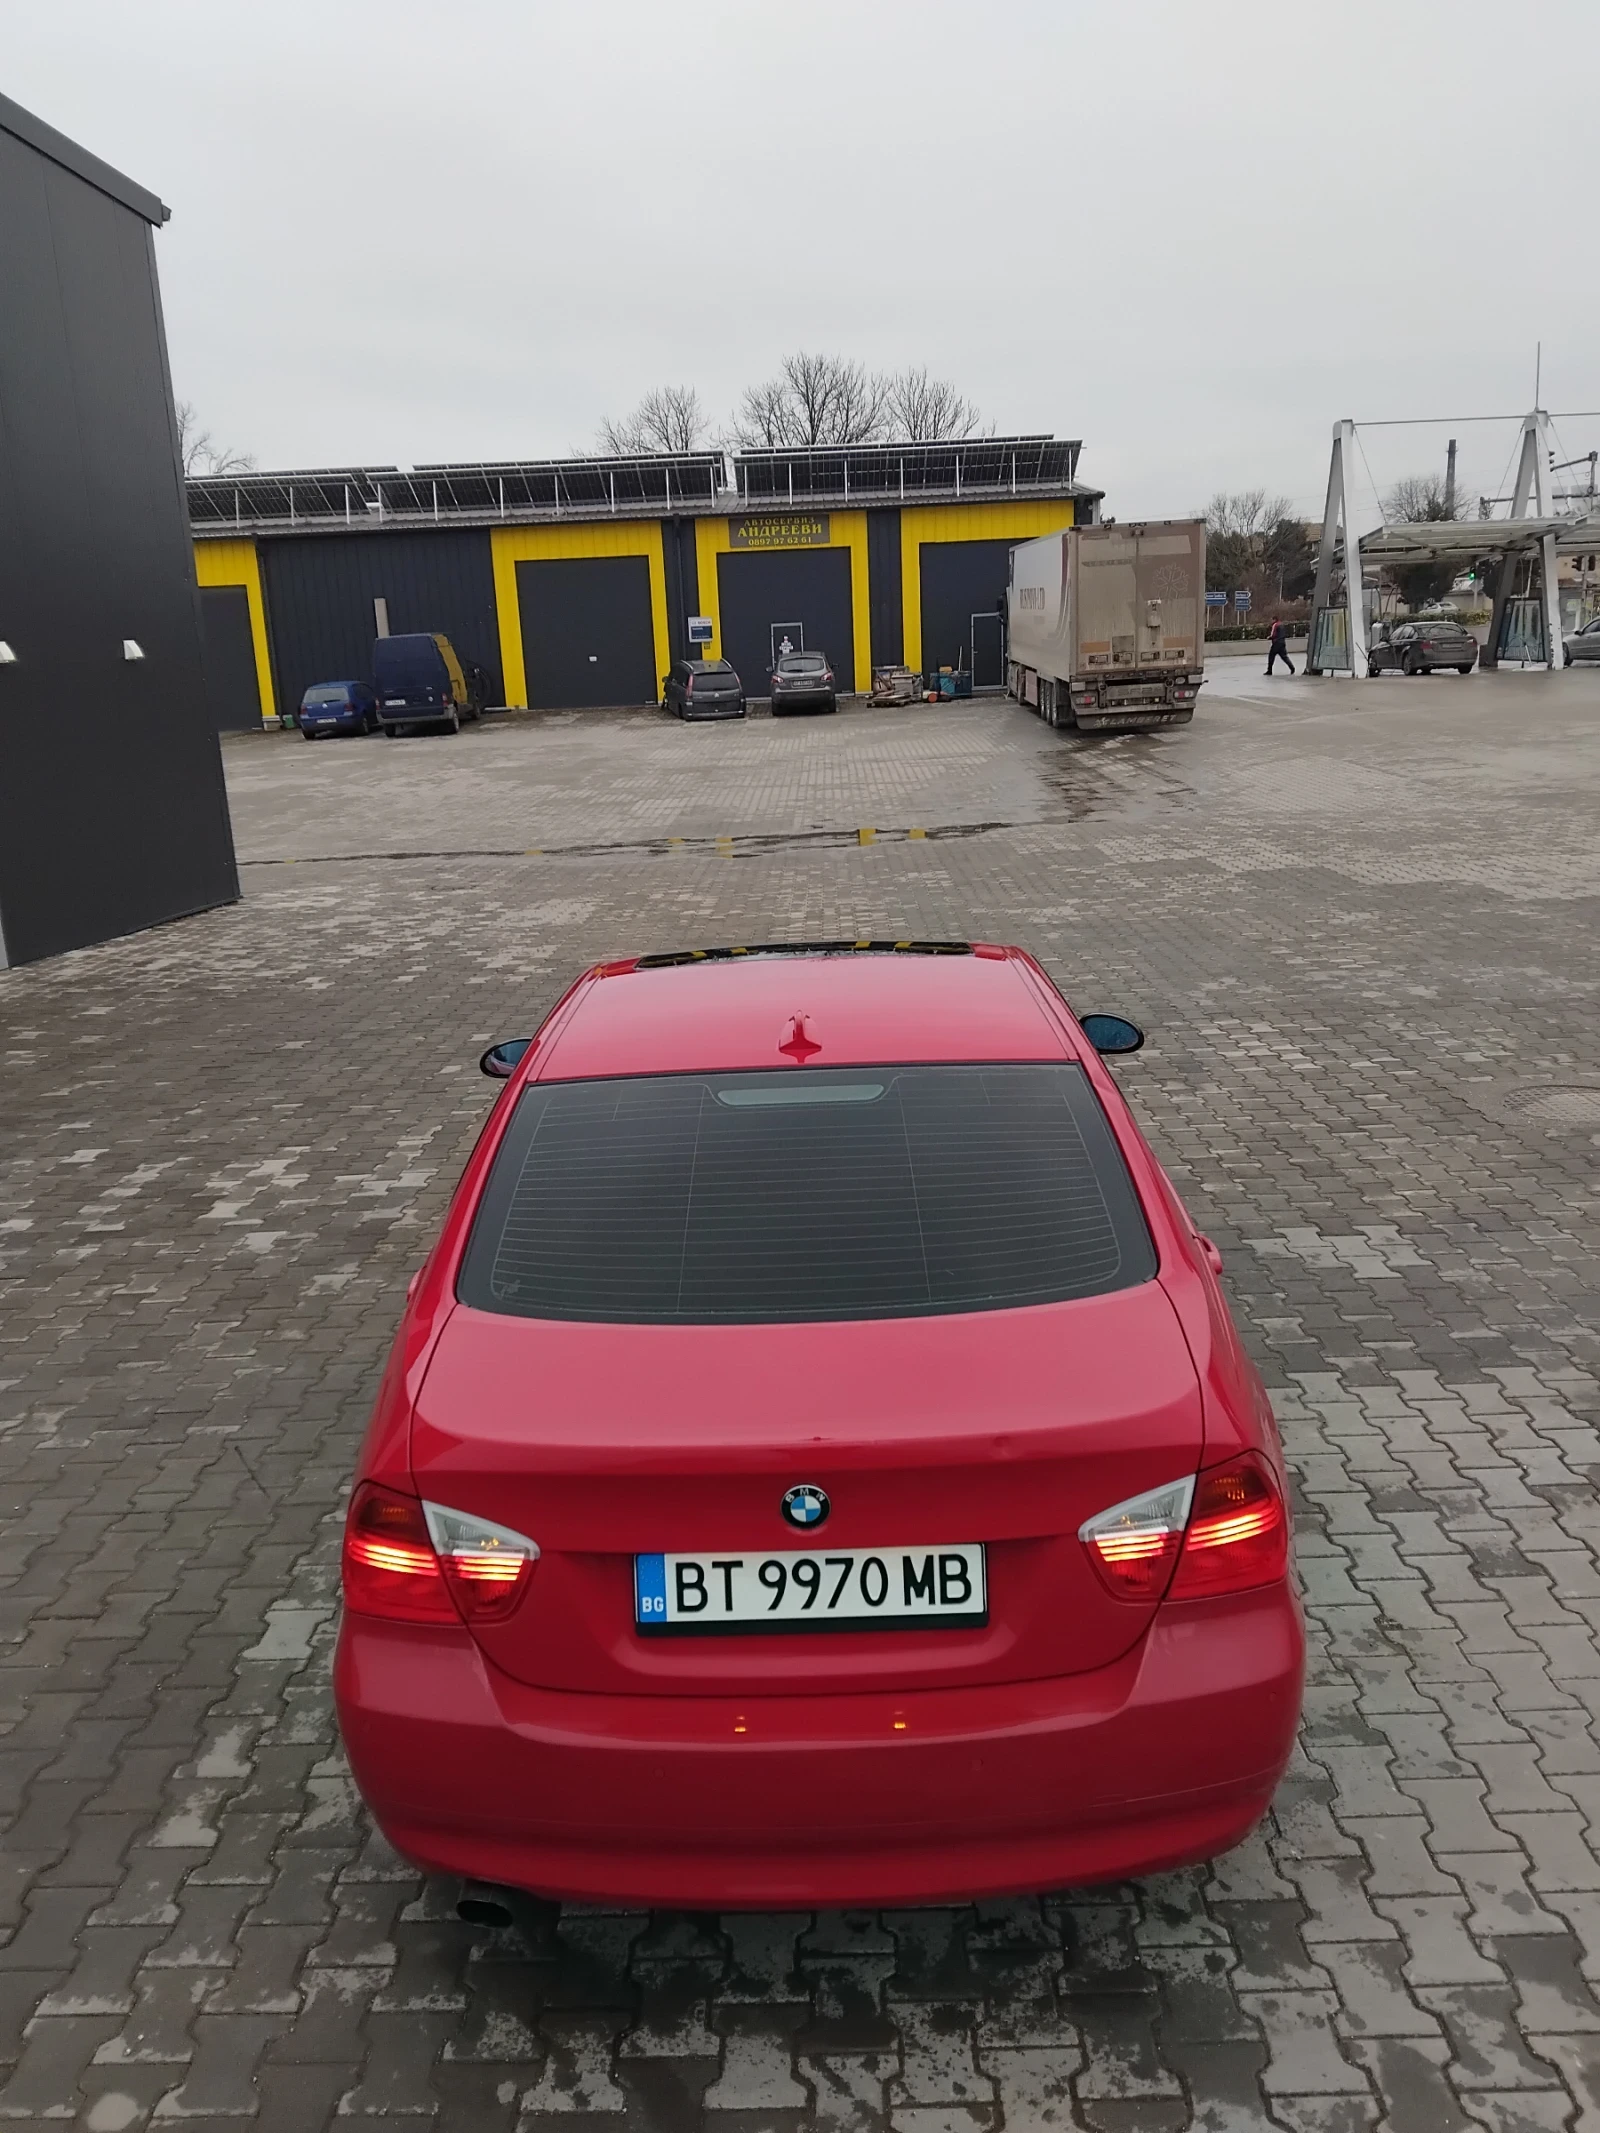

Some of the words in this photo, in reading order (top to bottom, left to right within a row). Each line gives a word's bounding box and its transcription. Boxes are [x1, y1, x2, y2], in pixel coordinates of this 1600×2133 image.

[744, 516, 815, 527] АВТОСЕРВИЗ
[738, 524, 822, 537] АНДРЕЕВИ
[748, 538, 771, 546] 0897
[773, 537, 785, 545] 97
[787, 536, 799, 545] 62
[801, 536, 811, 544] 61
[785, 1487, 826, 1503] BMW
[675, 1560, 744, 1613] BT
[758, 1556, 889, 1611] 9970
[902, 1554, 972, 1607] MB
[642, 1597, 664, 1613] BG
